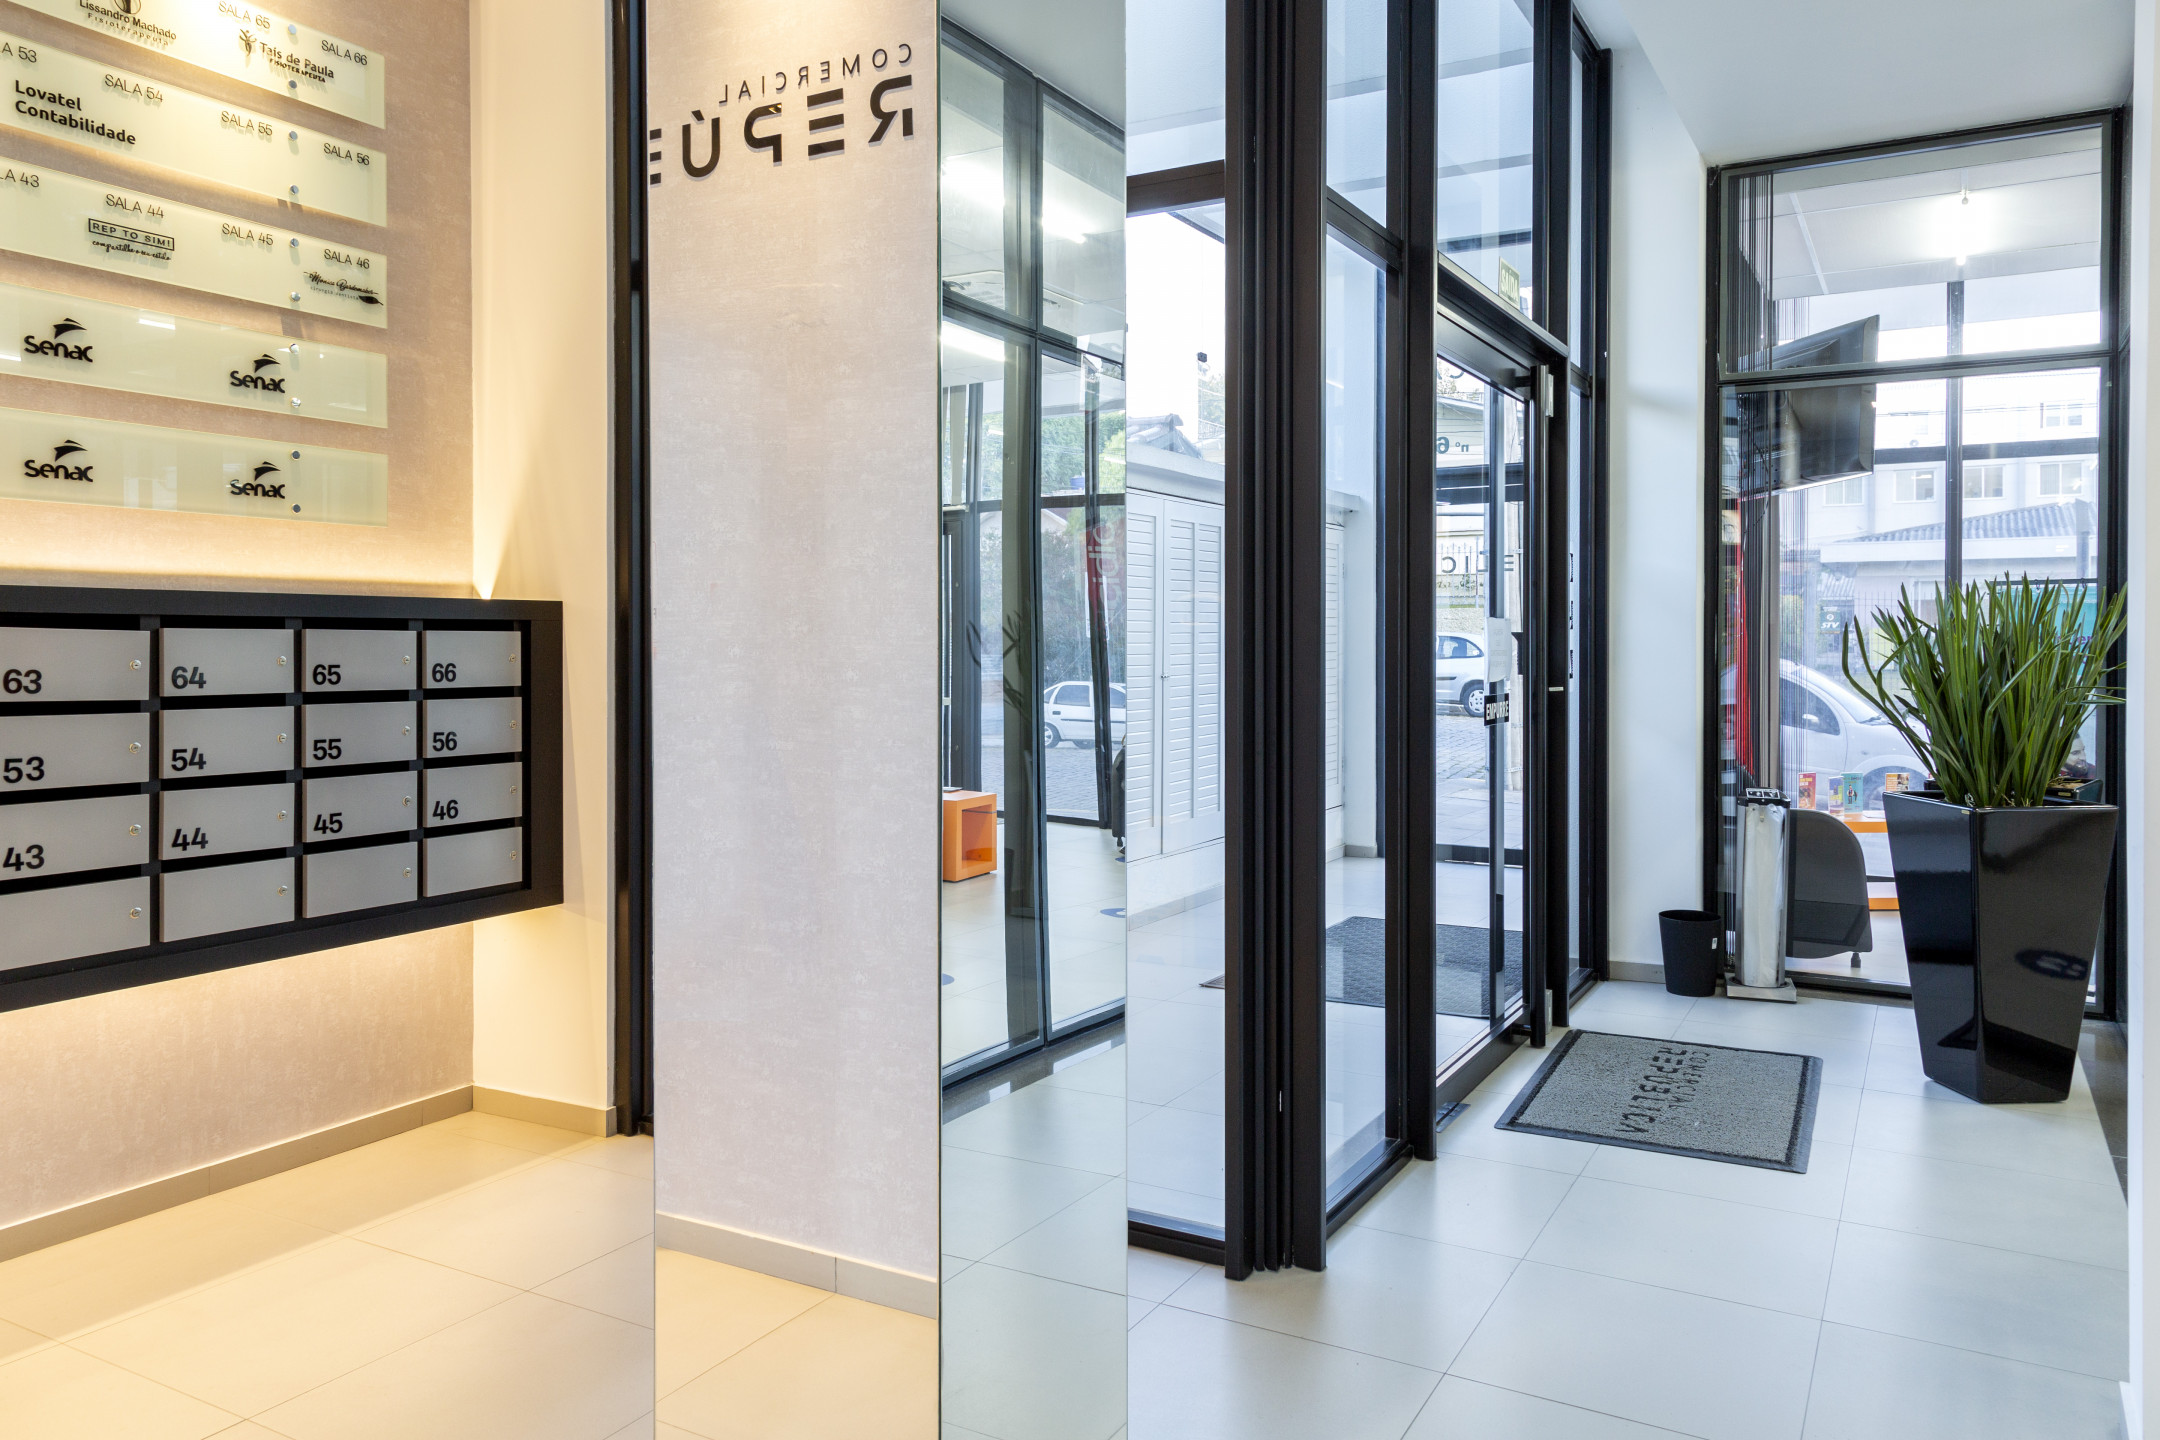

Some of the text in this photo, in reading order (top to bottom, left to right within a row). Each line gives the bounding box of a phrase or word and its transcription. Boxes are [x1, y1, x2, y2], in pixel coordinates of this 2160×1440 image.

[79, 0, 177, 40] Lissandro Machado
[218, 1, 271, 29] SALA 65
[18, 45, 37, 63] 53
[286, 53, 300, 66] de
[304, 58, 335, 78] Paula
[321, 40, 368, 66] SALA 66
[269, 58, 326, 83] FISIOTERAPEUTA
[15, 79, 82, 111] Lovatel
[104, 73, 164, 103] SALA 54
[15, 100, 136, 145] Contabilidade
[221, 110, 273, 136] SALA 55
[323, 142, 370, 166] SALA 56
[20, 172, 40, 188] 43
[105, 193, 164, 218] SALA 44
[92, 221, 117, 234] REP
[122, 229, 139, 240] TO
[221, 222, 274, 246] SALA 45
[323, 248, 370, 270] SALA 46
[1820, 621, 1840, 629] STV
[3, 668, 43, 695] 63
[171, 665, 207, 690] 64
[312, 663, 342, 687] 65
[431, 662, 457, 683] 66
[1485, 700, 1509, 721] EMPURRE
[312, 738, 342, 761] 55
[432, 731, 458, 752] 56
[3, 755, 45, 784] 53
[170, 747, 207, 772] 54
[432, 799, 459, 821] 46
[313, 812, 343, 835] 45
[171, 827, 208, 852] 44
[2, 843, 45, 872] 43
